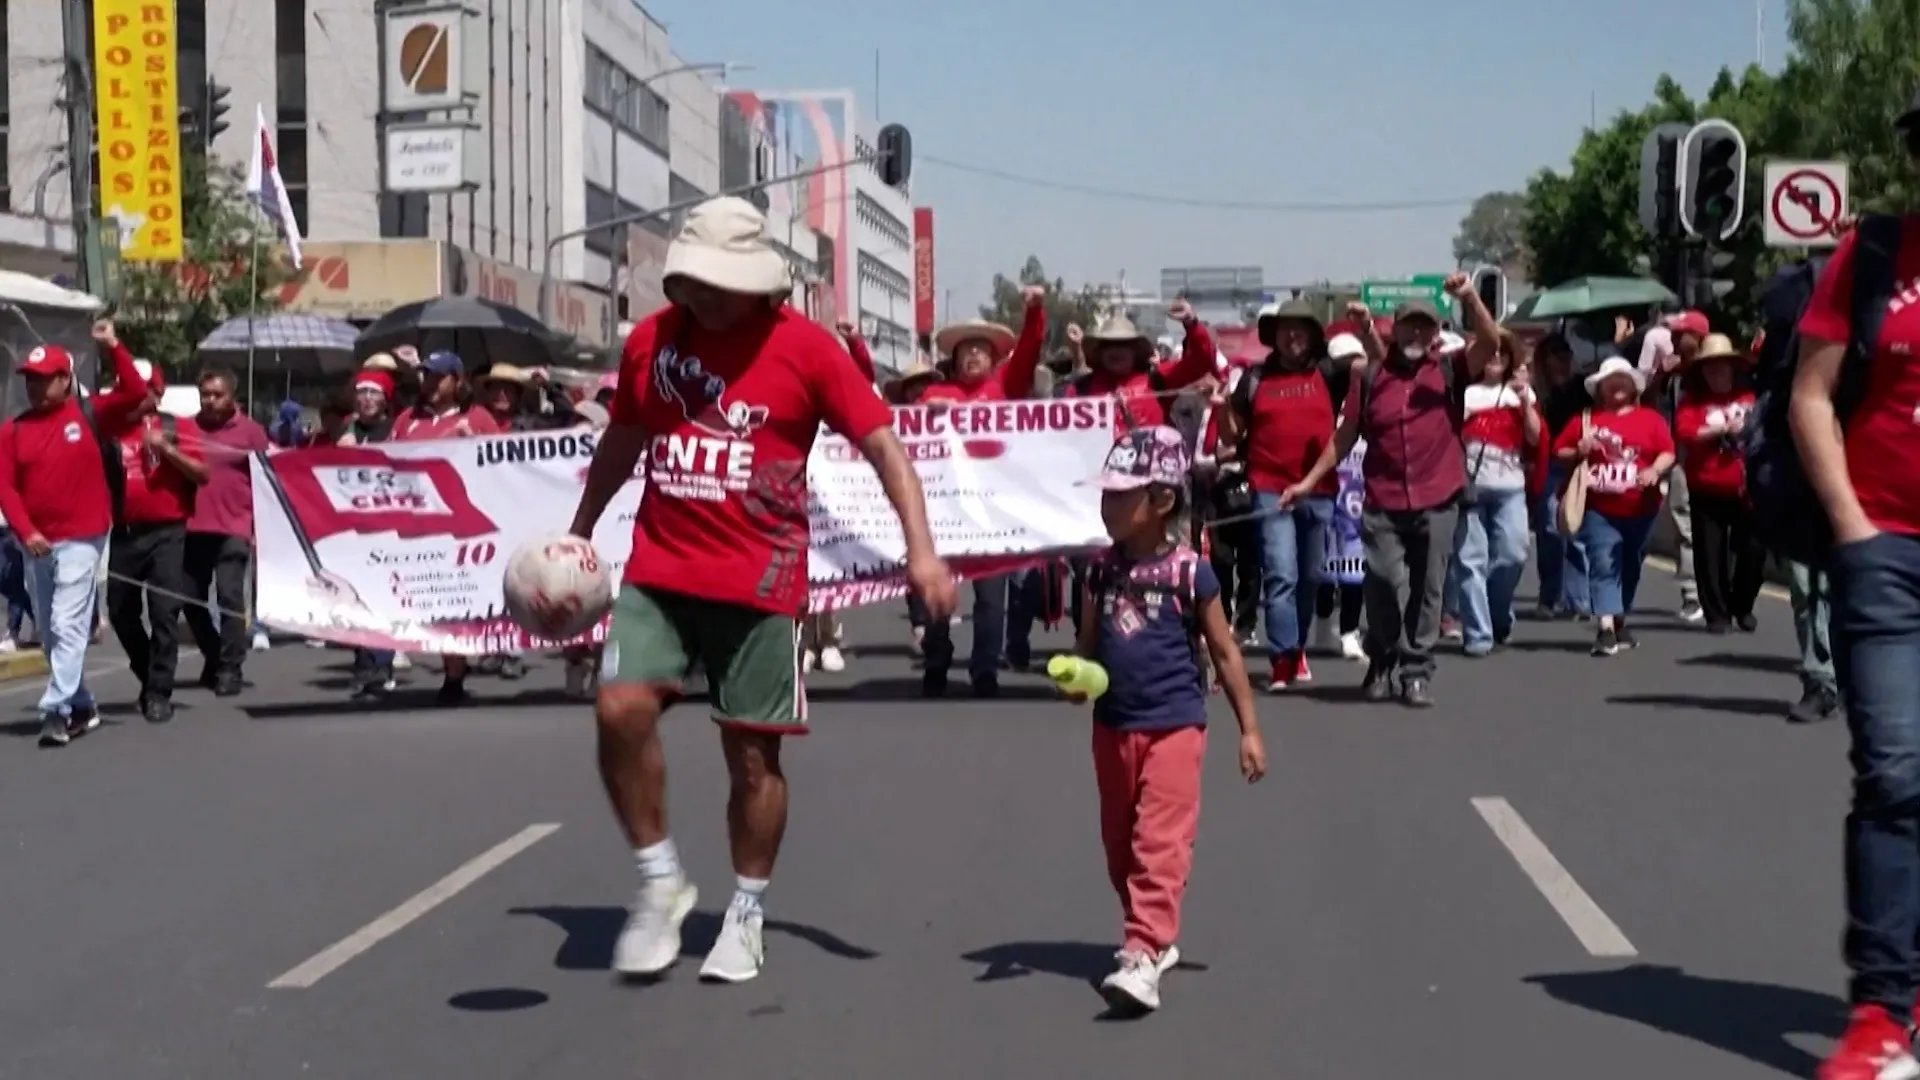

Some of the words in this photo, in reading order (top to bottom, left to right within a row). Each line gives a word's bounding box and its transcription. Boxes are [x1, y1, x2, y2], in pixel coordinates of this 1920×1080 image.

[105, 14, 136, 194] POLLOS
[141, 4, 173, 247] ROSTIZADOS
[889, 401, 1108, 437] NCEREMOS!
[477, 432, 595, 467] ¡UNIDOS
[651, 434, 755, 479] CNTE
[456, 540, 497, 567] 10
